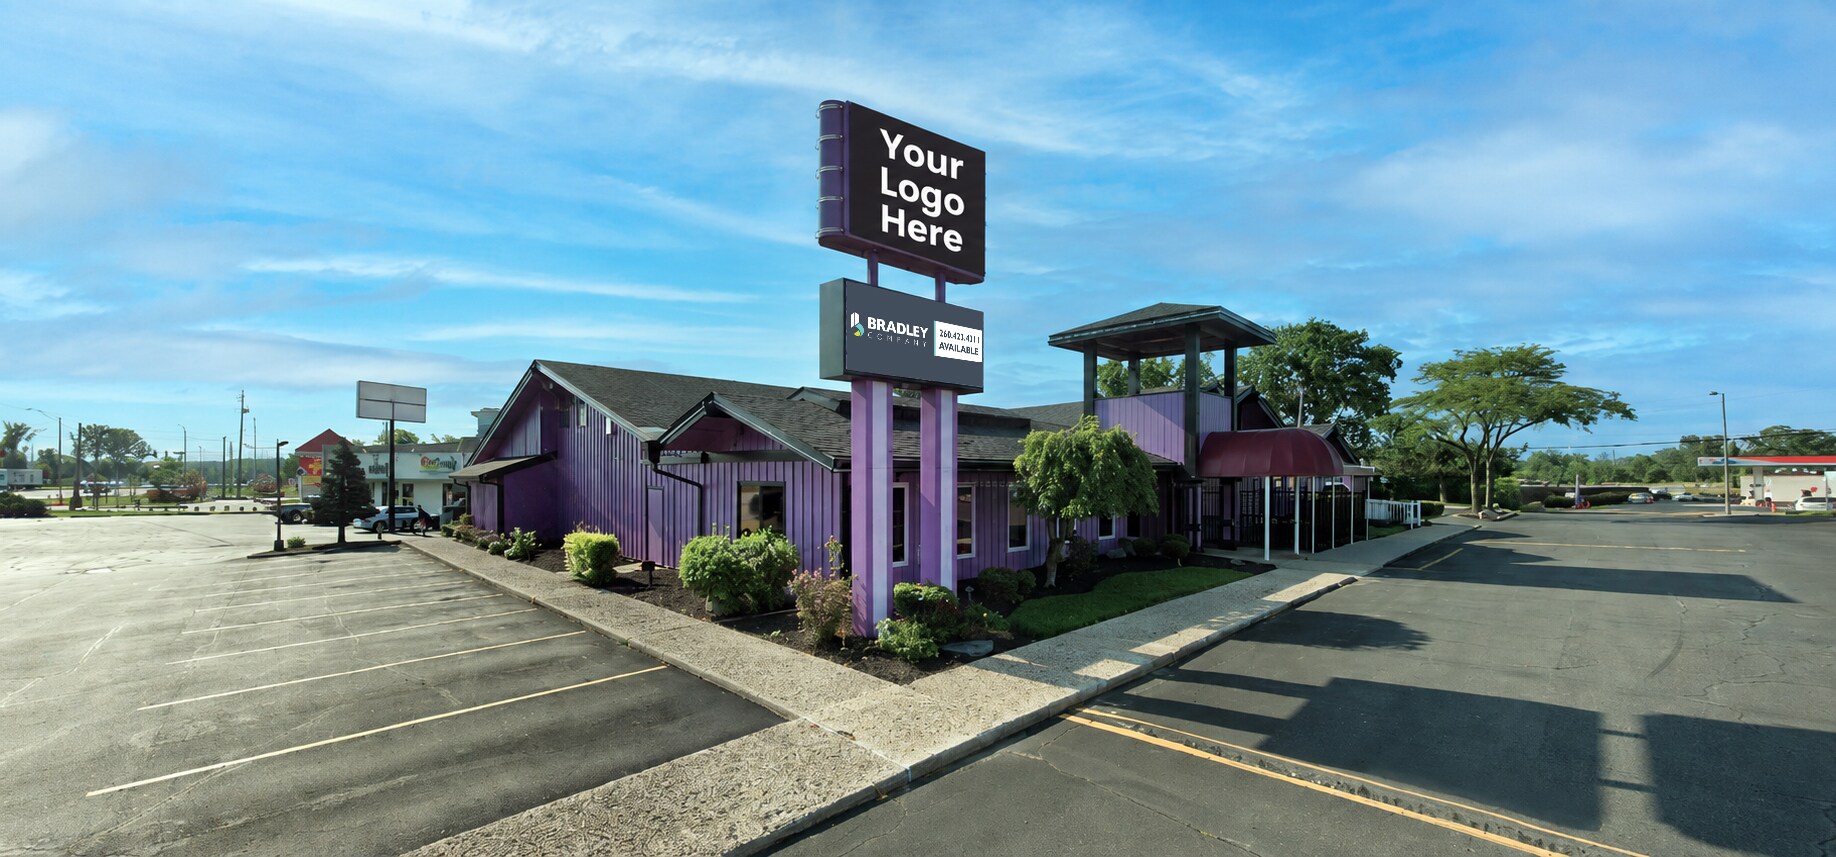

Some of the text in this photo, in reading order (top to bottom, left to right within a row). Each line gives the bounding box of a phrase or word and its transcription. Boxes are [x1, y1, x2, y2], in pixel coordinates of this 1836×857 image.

[880, 128, 963, 179] Your
[881, 167, 965, 217] Logo
[881, 204, 963, 252] Here
[867, 316, 929, 339] BRADLEY
[939, 342, 979, 356] AVAILABLE
